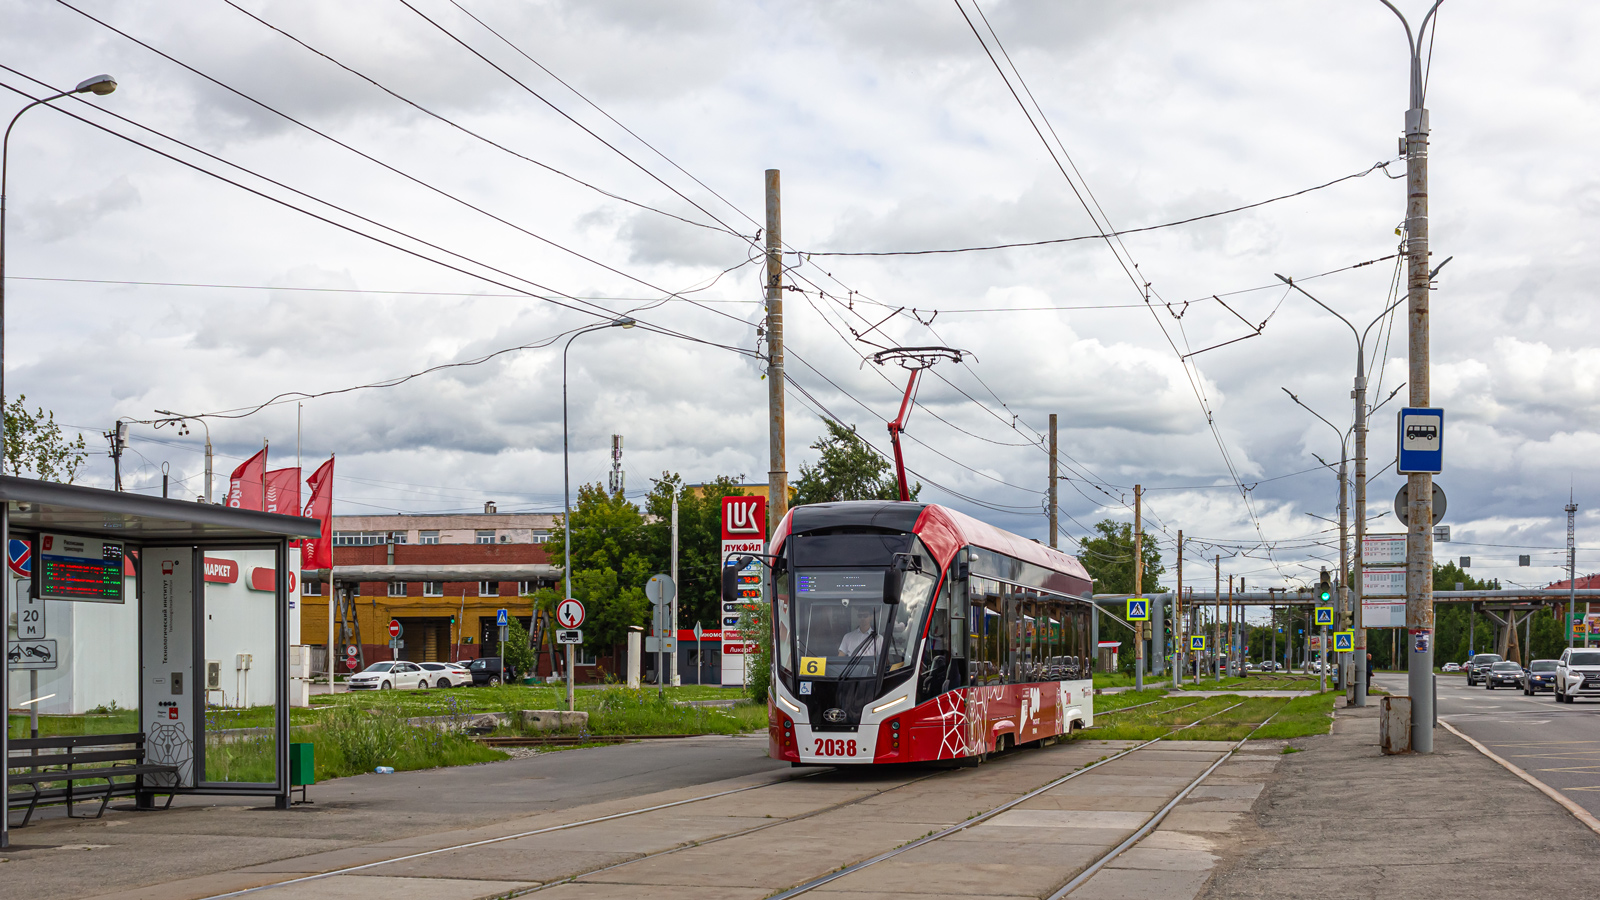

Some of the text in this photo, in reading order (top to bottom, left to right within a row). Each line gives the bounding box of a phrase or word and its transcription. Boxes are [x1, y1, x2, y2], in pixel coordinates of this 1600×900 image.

[724, 543, 761, 551] ЛУКОЙЛ
[204, 563, 230, 577] МАРКЕТ
[23, 610, 39, 622] 20
[806, 660, 818, 674] 6
[814, 737, 857, 757] 2038
